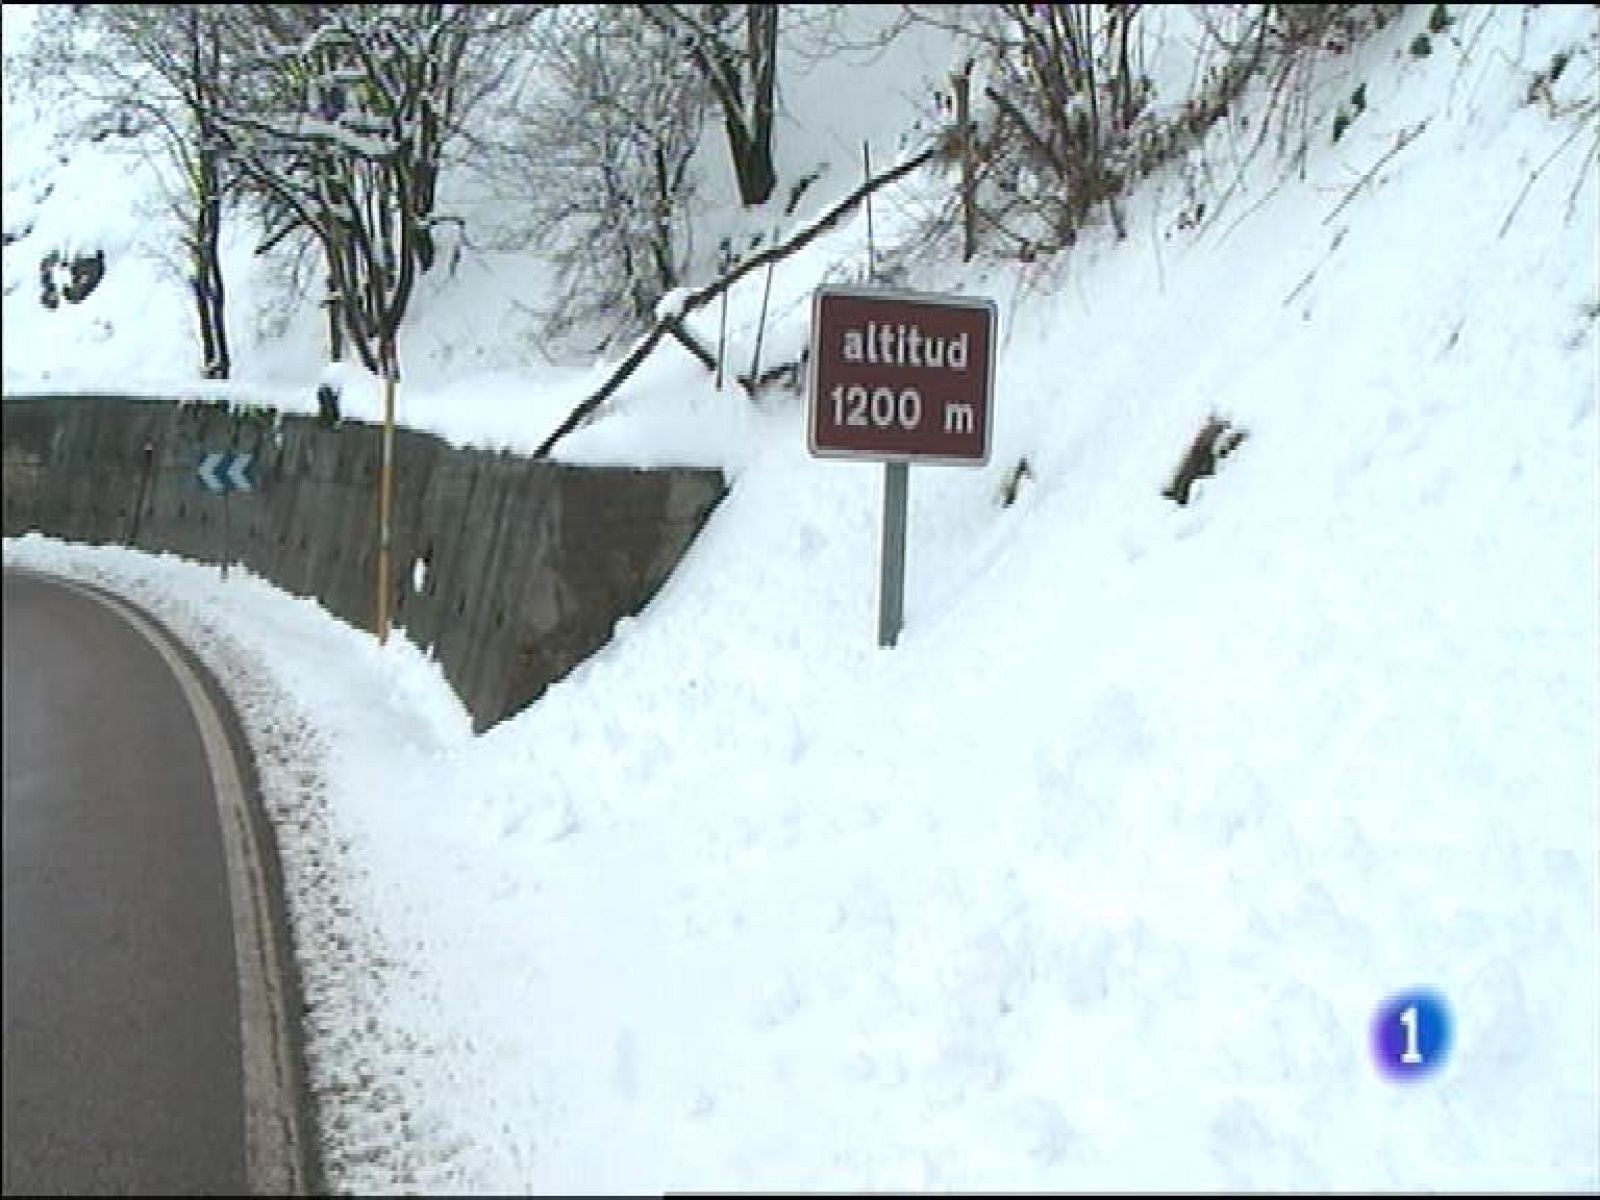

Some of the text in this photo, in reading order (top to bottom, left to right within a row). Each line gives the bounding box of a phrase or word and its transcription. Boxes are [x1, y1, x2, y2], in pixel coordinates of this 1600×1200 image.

[843, 320, 969, 369] altitud
[831, 385, 974, 434] 1200 m
